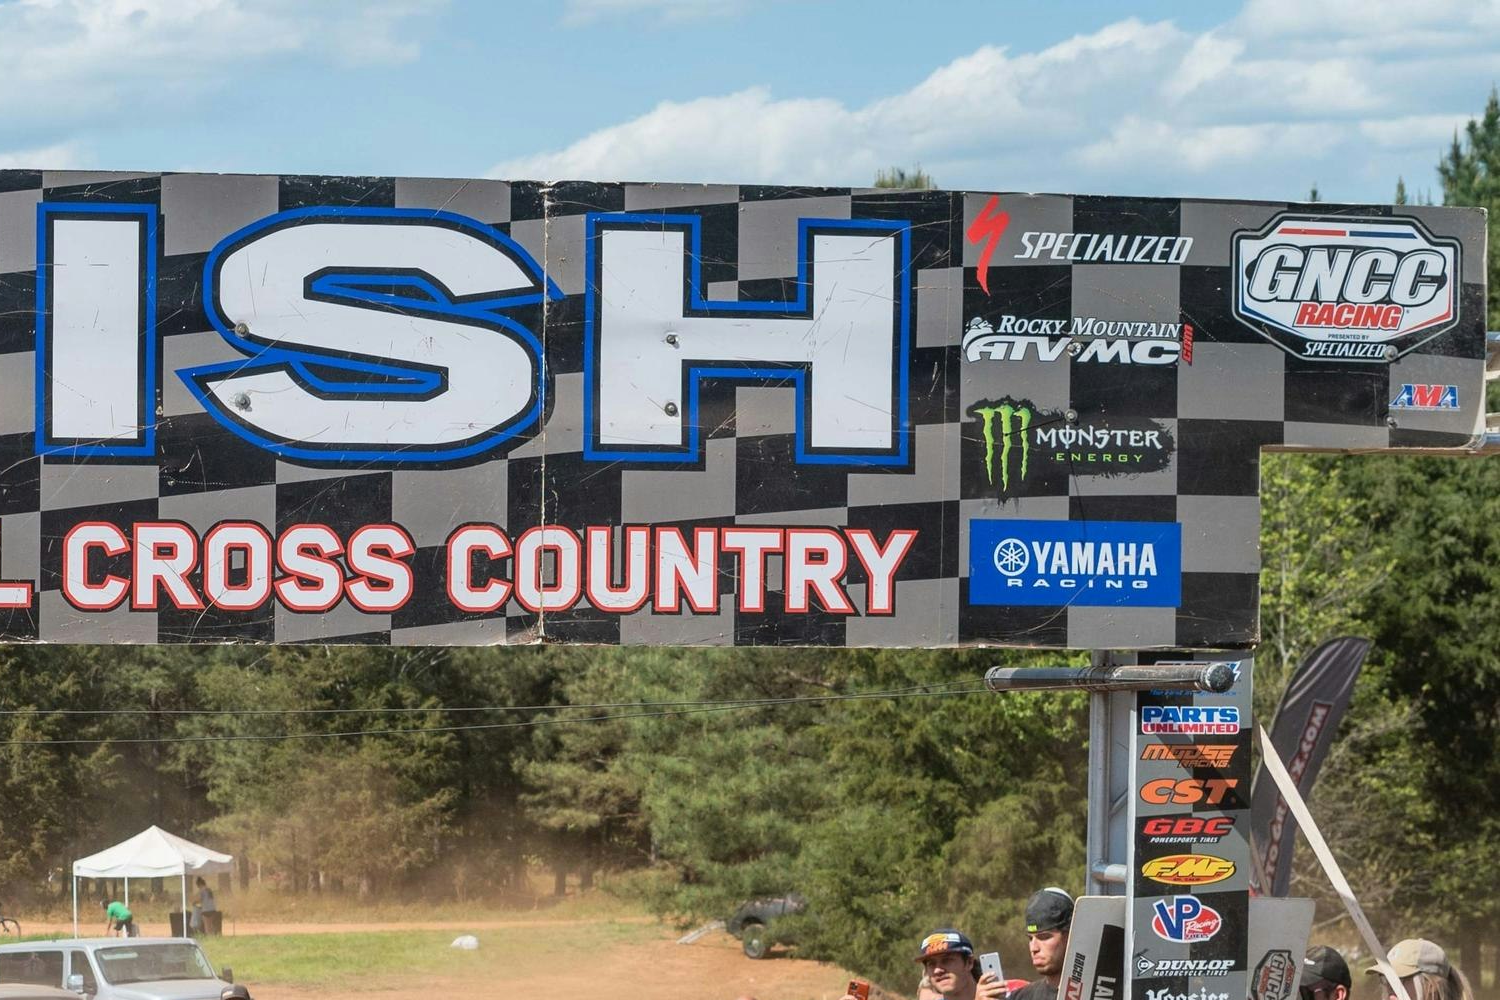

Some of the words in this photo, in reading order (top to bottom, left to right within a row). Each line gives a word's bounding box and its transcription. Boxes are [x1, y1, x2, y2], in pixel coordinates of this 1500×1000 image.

[1014, 232, 1194, 264] SPECIALIZED
[1248, 244, 1447, 307] GNCC
[1292, 302, 1404, 330] RACING
[996, 315, 1067, 335] ROCKY
[1070, 318, 1182, 339] MOUNTAIN
[1302, 341, 1387, 358] SPECIALIZED
[1389, 384, 1460, 409] AMA
[1035, 425, 1163, 450] MONSTER
[1056, 452, 1143, 463] ENERGY
[1032, 541, 1158, 576] YAMAHA
[62, 521, 415, 614] CROSS
[445, 523, 921, 618] COUNTRY
[1007, 578, 1148, 589] RACING
[1143, 707, 1238, 722] PARTS
[1143, 723, 1238, 734] UNLIMITED
[1140, 744, 1239, 760] MOOSE
[1177, 759, 1230, 768] RACING
[1143, 817, 1235, 836] GBC
[1143, 858, 1234, 877] FMF
[1153, 895, 1201, 940] VP
[1155, 959, 1236, 970] DUNLOP
